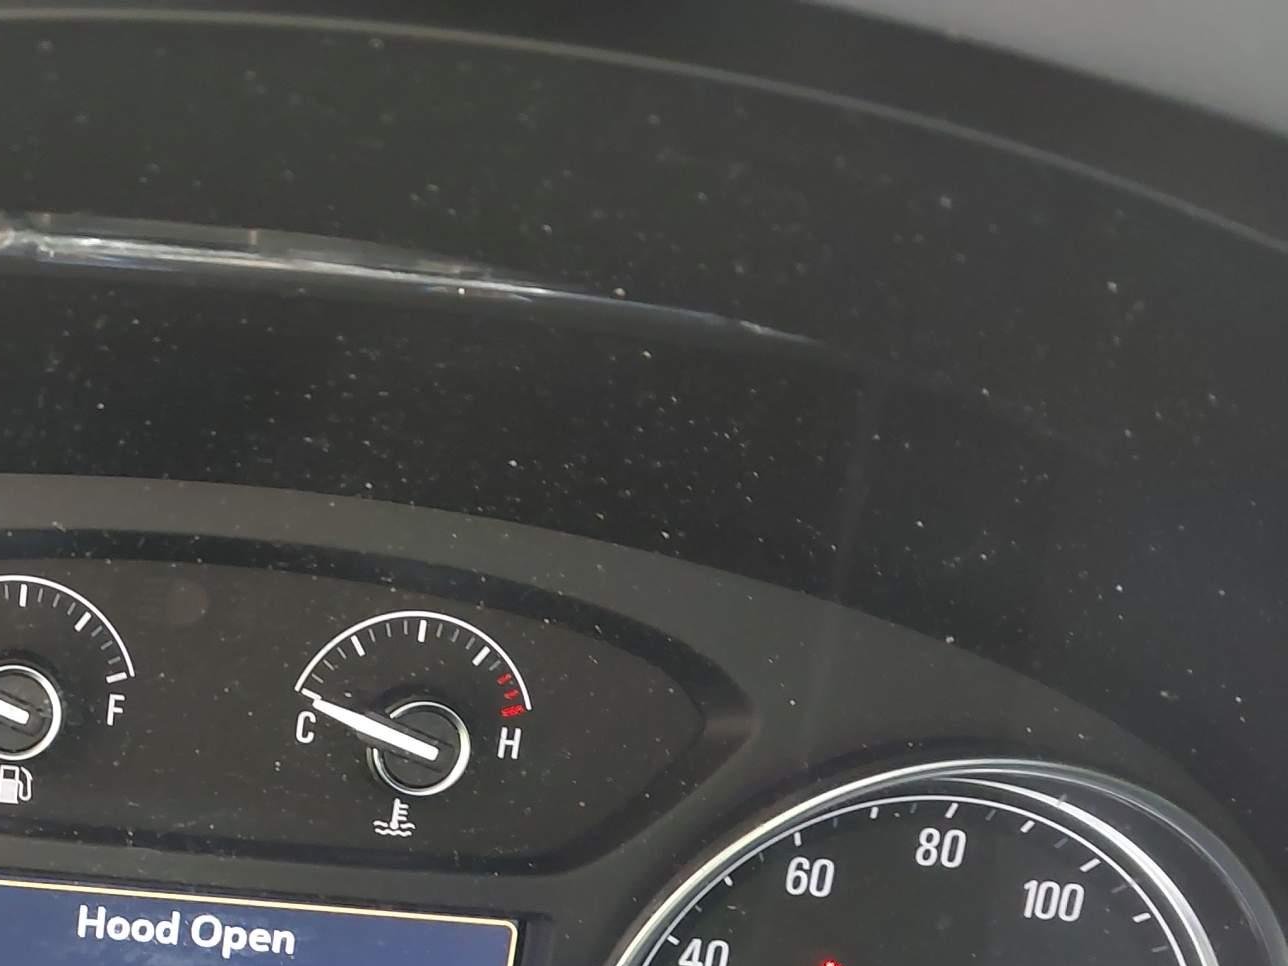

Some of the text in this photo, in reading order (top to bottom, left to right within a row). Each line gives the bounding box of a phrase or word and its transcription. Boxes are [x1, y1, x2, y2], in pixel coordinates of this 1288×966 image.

[106, 693, 125, 726] F
[295, 711, 317, 744] C
[497, 727, 523, 760] H
[915, 827, 967, 868] 80
[786, 856, 835, 898] 60
[1023, 879, 1085, 922] 100
[77, 904, 296, 960] Hood Open
